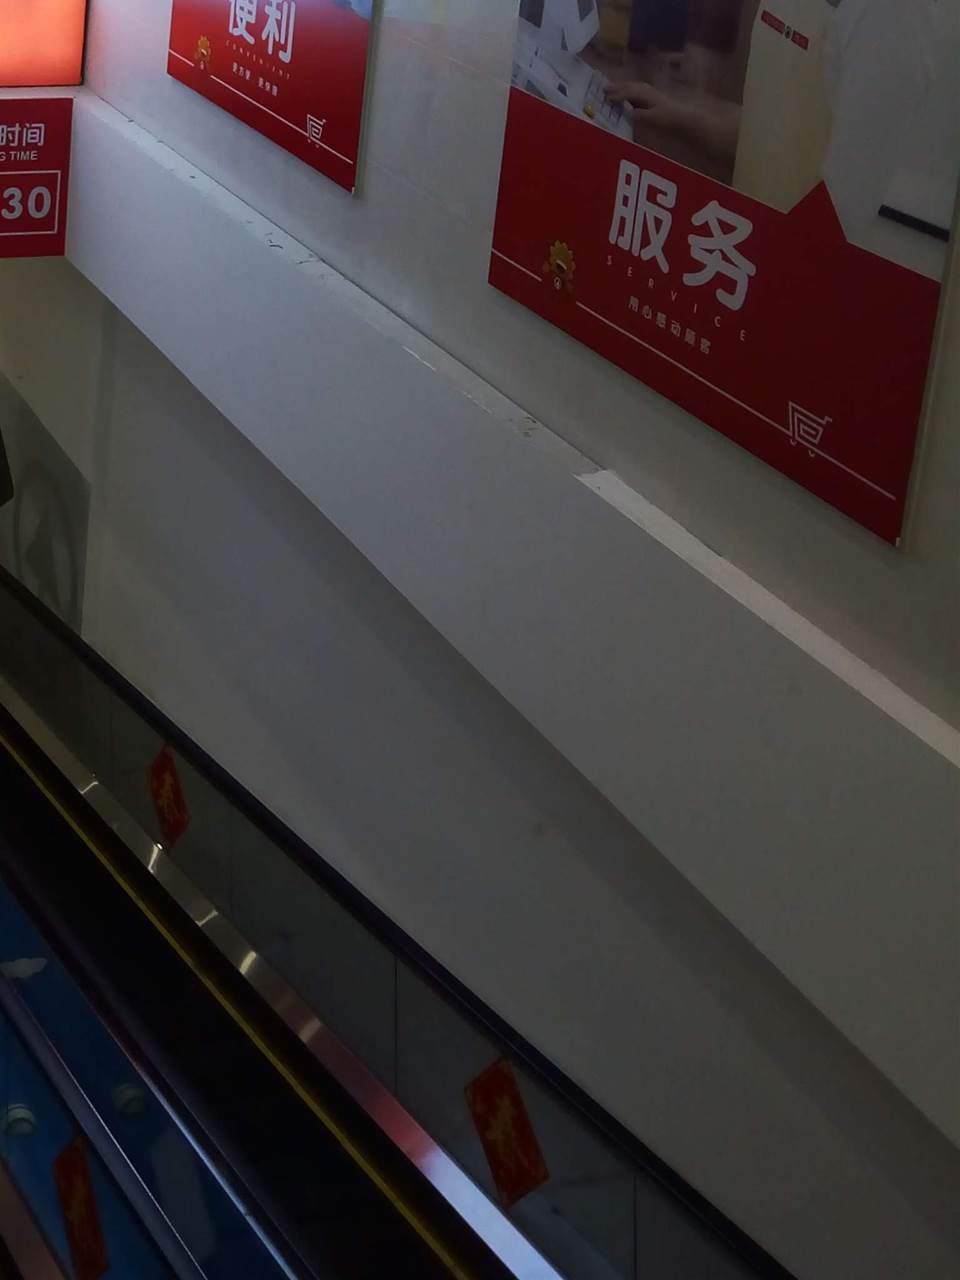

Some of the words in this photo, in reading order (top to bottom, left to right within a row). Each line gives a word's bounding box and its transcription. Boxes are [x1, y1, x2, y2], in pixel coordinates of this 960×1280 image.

[10, 150, 38, 161] TIME
[608, 158, 757, 311] 服务
[606, 255, 747, 342] SERVICE
